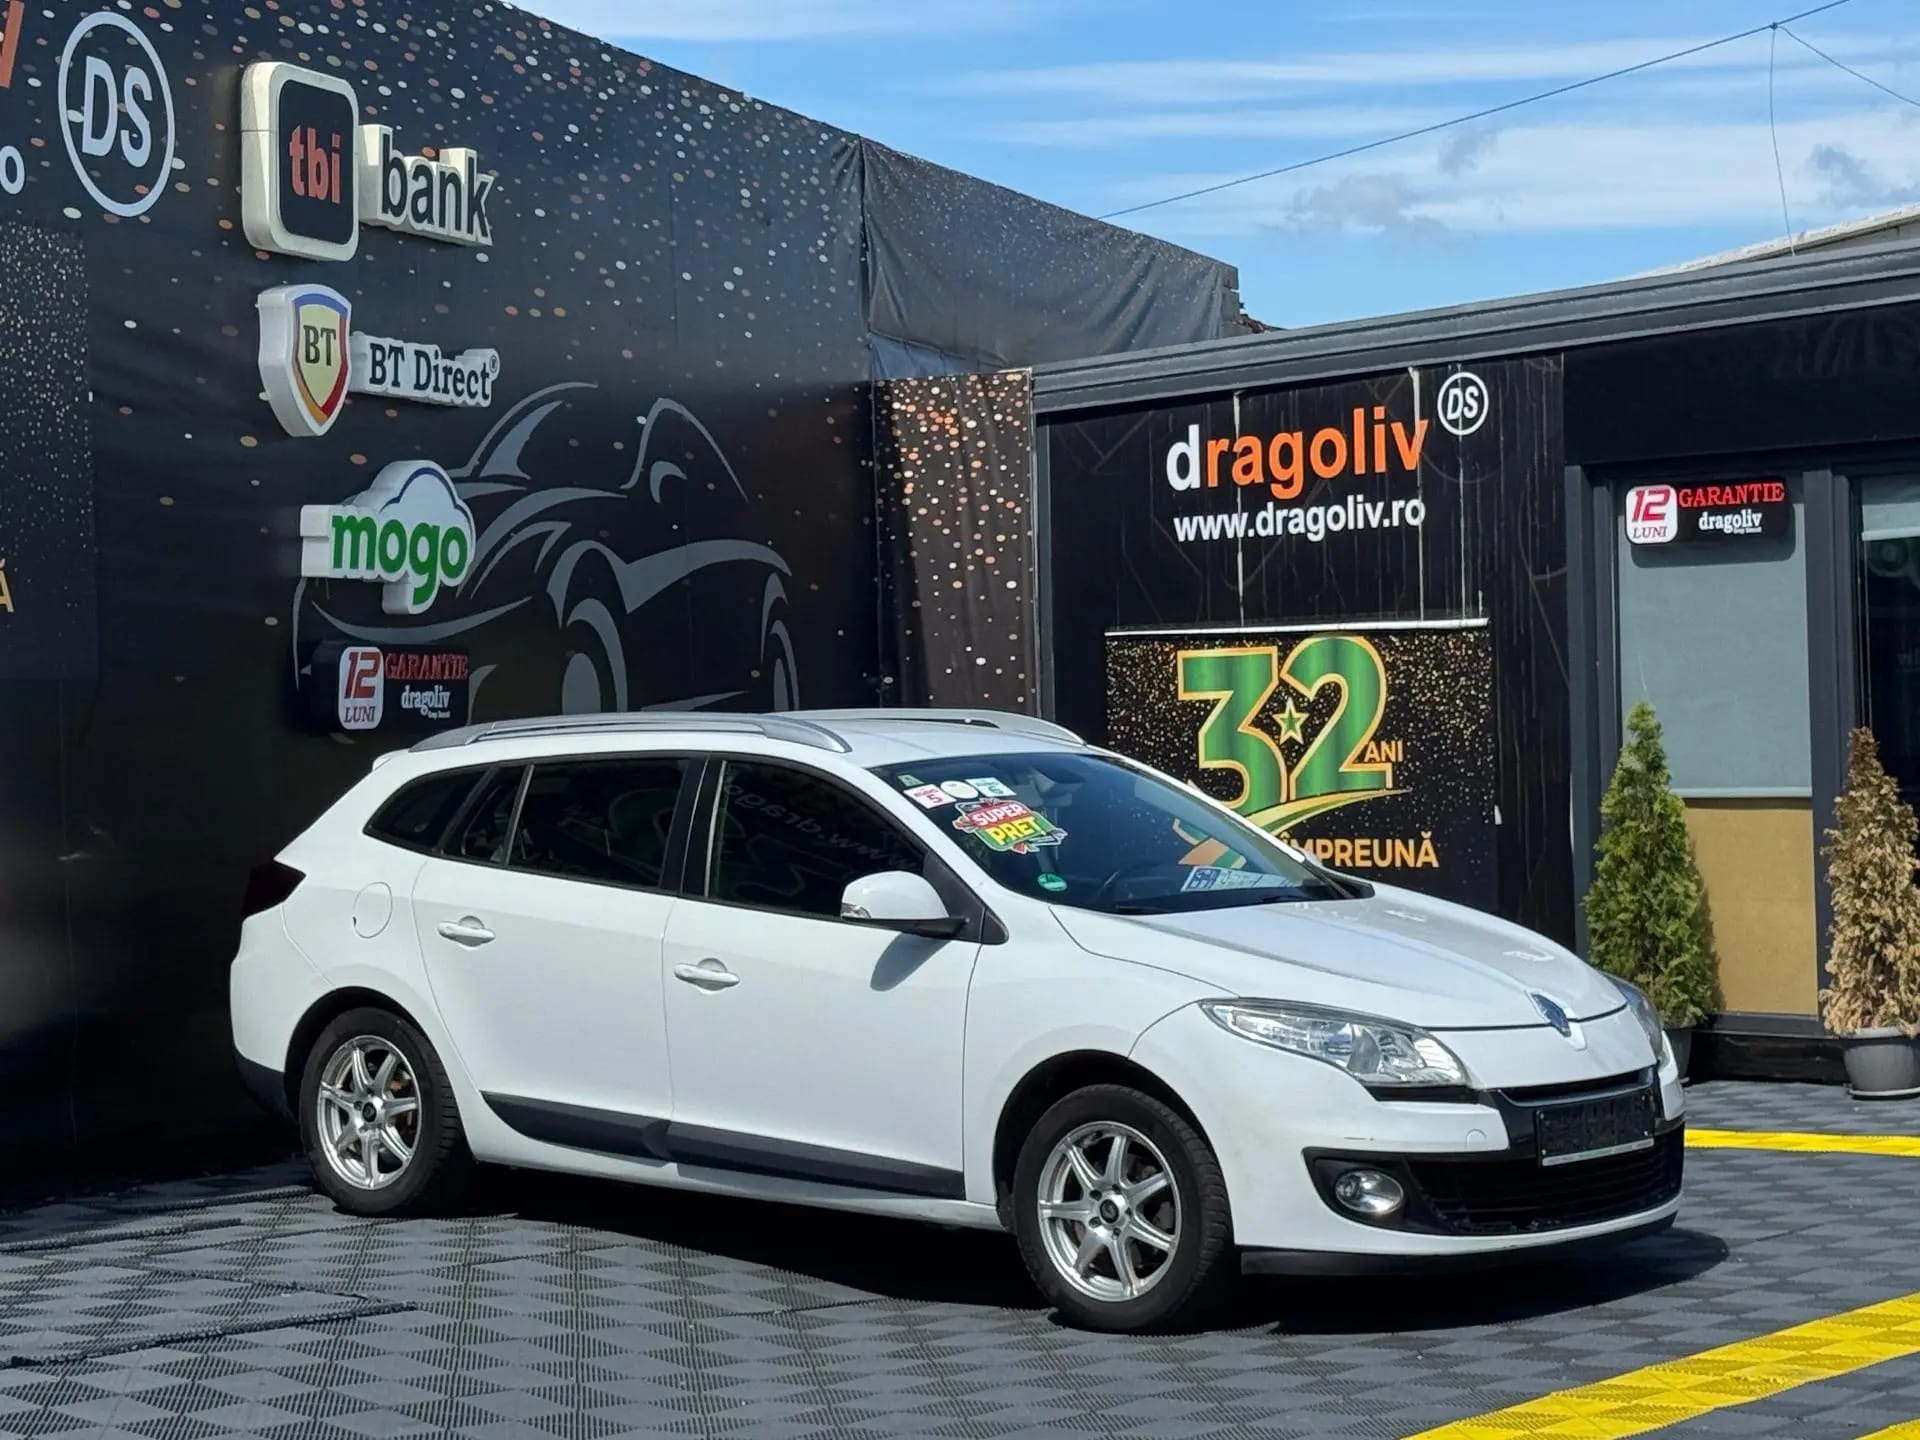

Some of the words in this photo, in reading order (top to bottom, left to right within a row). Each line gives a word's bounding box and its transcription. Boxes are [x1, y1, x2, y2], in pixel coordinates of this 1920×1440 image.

[82, 56, 153, 167] DS
[289, 124, 341, 204] tbi
[381, 133, 489, 238] bank
[304, 325, 337, 367] BT
[369, 342, 405, 388] BT
[1446, 385, 1480, 420] DS
[1166, 405, 1429, 500] dragoliv
[1632, 488, 1671, 522] 12
[1678, 482, 1785, 508] GARANTIE
[1173, 494, 1426, 543] www.dragoliv.ro
[1632, 526, 1668, 539] LUNI
[1698, 508, 1762, 534] dragoliv
[331, 513, 468, 606] mogo
[344, 652, 380, 699] 12
[384, 653, 469, 680] GARANTIE
[343, 706, 376, 723] LUNI
[401, 684, 451, 717] dragoliv
[1177, 635, 1393, 812] 32
[1364, 739, 1404, 764] ANI
[971, 803, 1028, 826] SUPER
